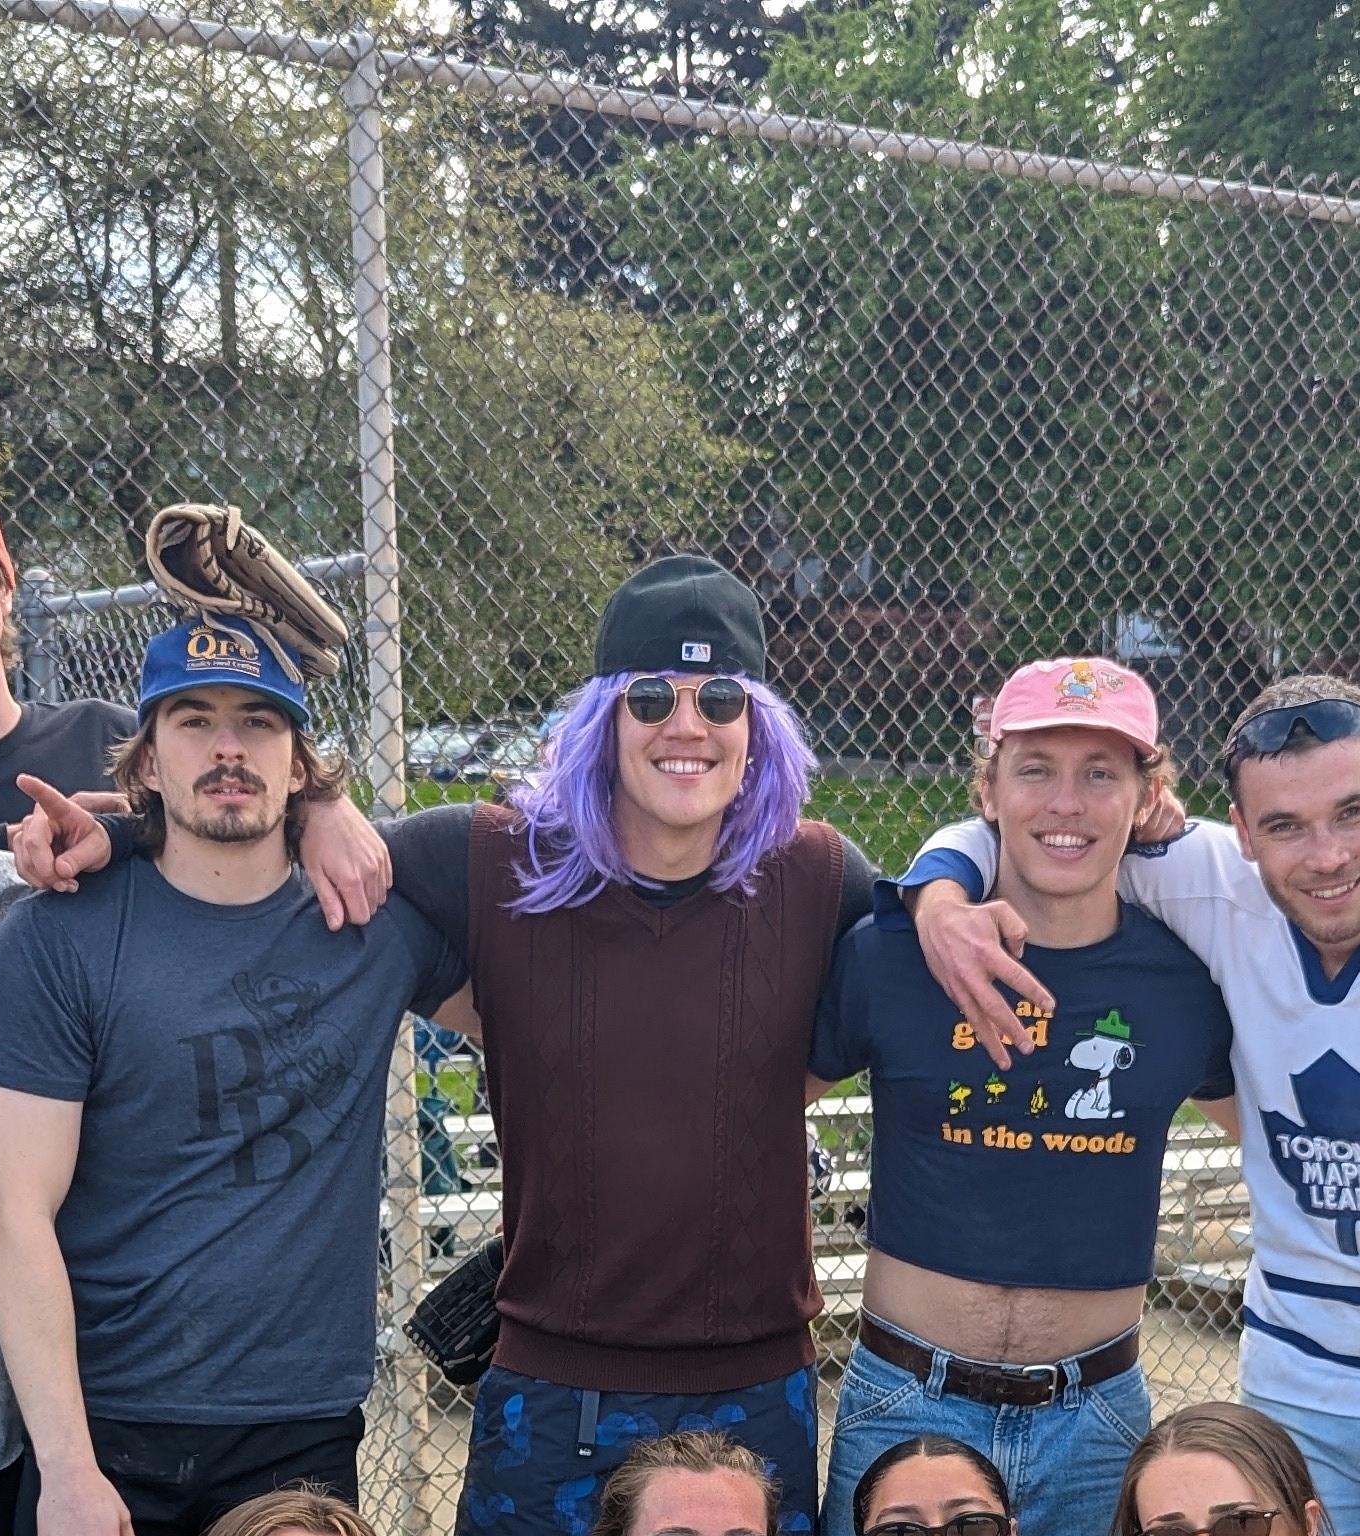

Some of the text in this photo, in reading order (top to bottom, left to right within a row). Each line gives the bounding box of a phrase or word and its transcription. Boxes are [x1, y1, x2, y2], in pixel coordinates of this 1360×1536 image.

[952, 1021, 1048, 1050] gd
[942, 1123, 1137, 1154] in the woods
